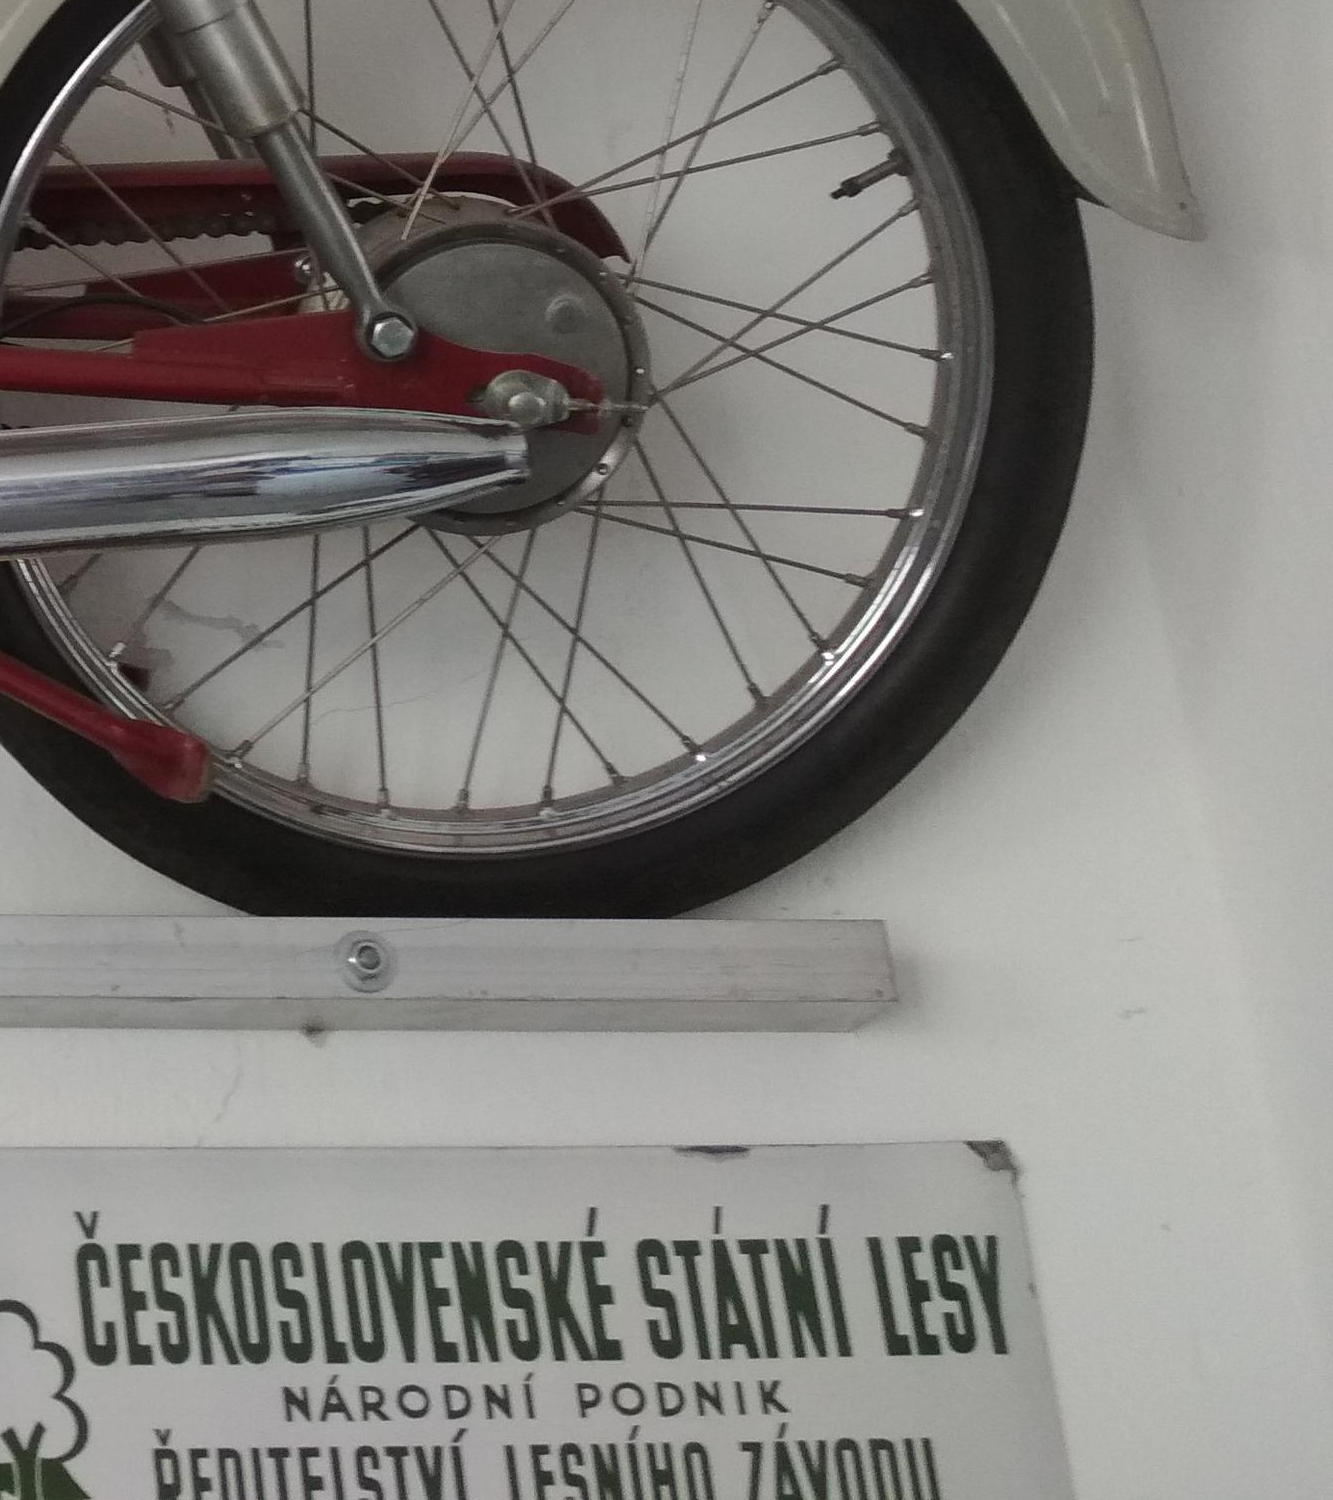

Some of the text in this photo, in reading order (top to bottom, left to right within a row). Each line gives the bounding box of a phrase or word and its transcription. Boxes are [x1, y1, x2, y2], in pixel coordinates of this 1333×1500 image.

[73, 1204, 1010, 1366] ČESKOSLOVENSKÉ STÁTNÍ LESY
[281, 1372, 790, 1423] NÁRODNÍ PODNIK
